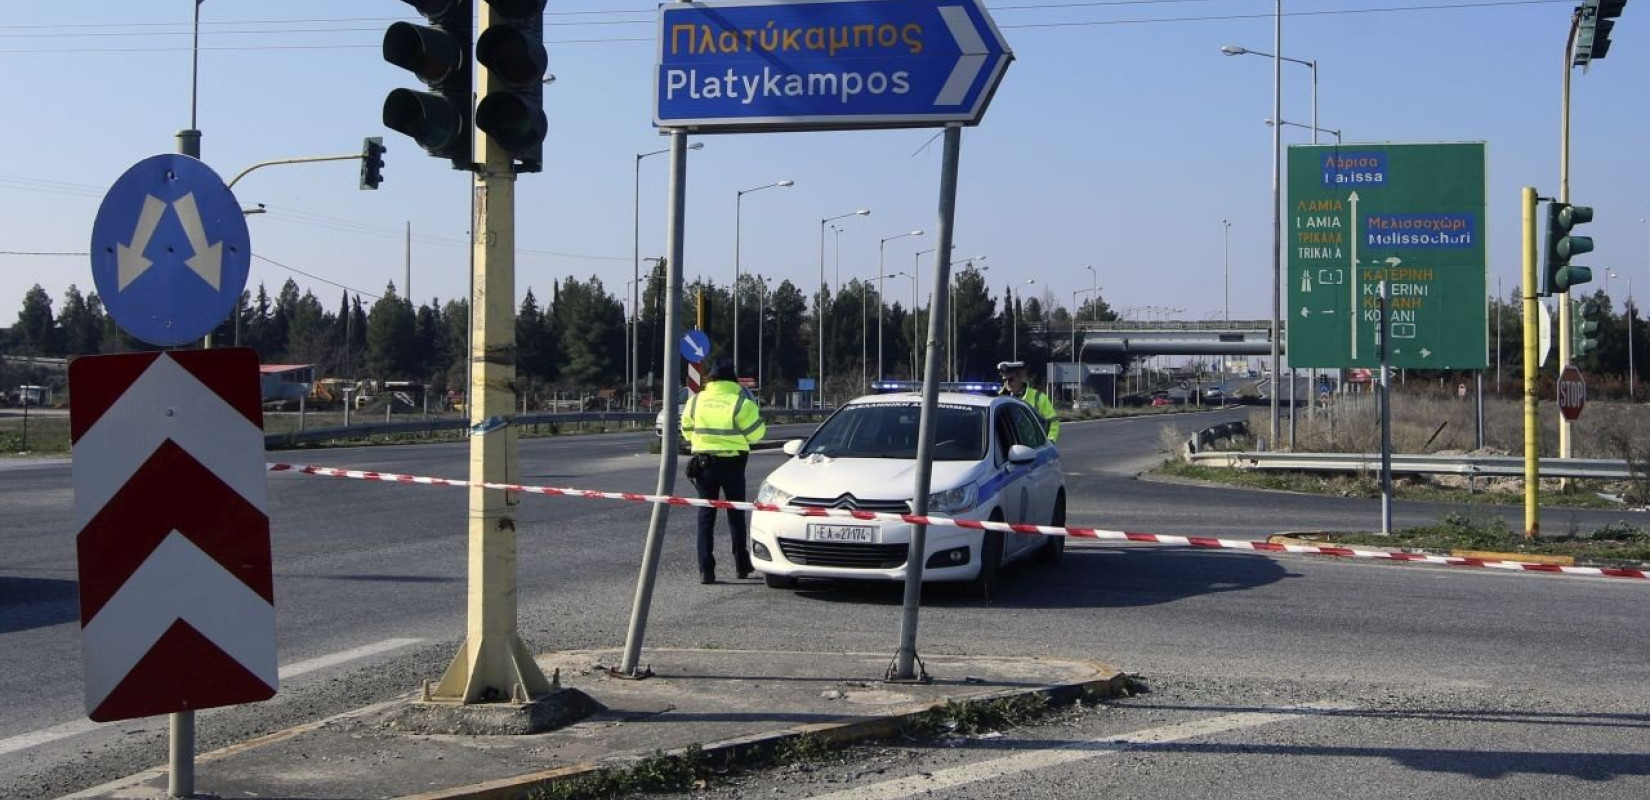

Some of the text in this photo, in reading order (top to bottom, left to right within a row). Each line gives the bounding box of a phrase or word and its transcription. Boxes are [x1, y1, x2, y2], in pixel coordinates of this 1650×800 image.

[671, 20, 924, 57] Πλατύκαμπος
[667, 67, 911, 105] Platykampos
[1325, 156, 1378, 170] Λάρισα
[1368, 216, 1465, 231] Μελισσοχώρι
[1363, 283, 1428, 296] KAERINI
[1363, 297, 1423, 309] ΚΟΑΝΗ
[1364, 309, 1415, 322] KOANI
[1560, 380, 1584, 409] STOP
[841, 528, 866, 540] 27174
